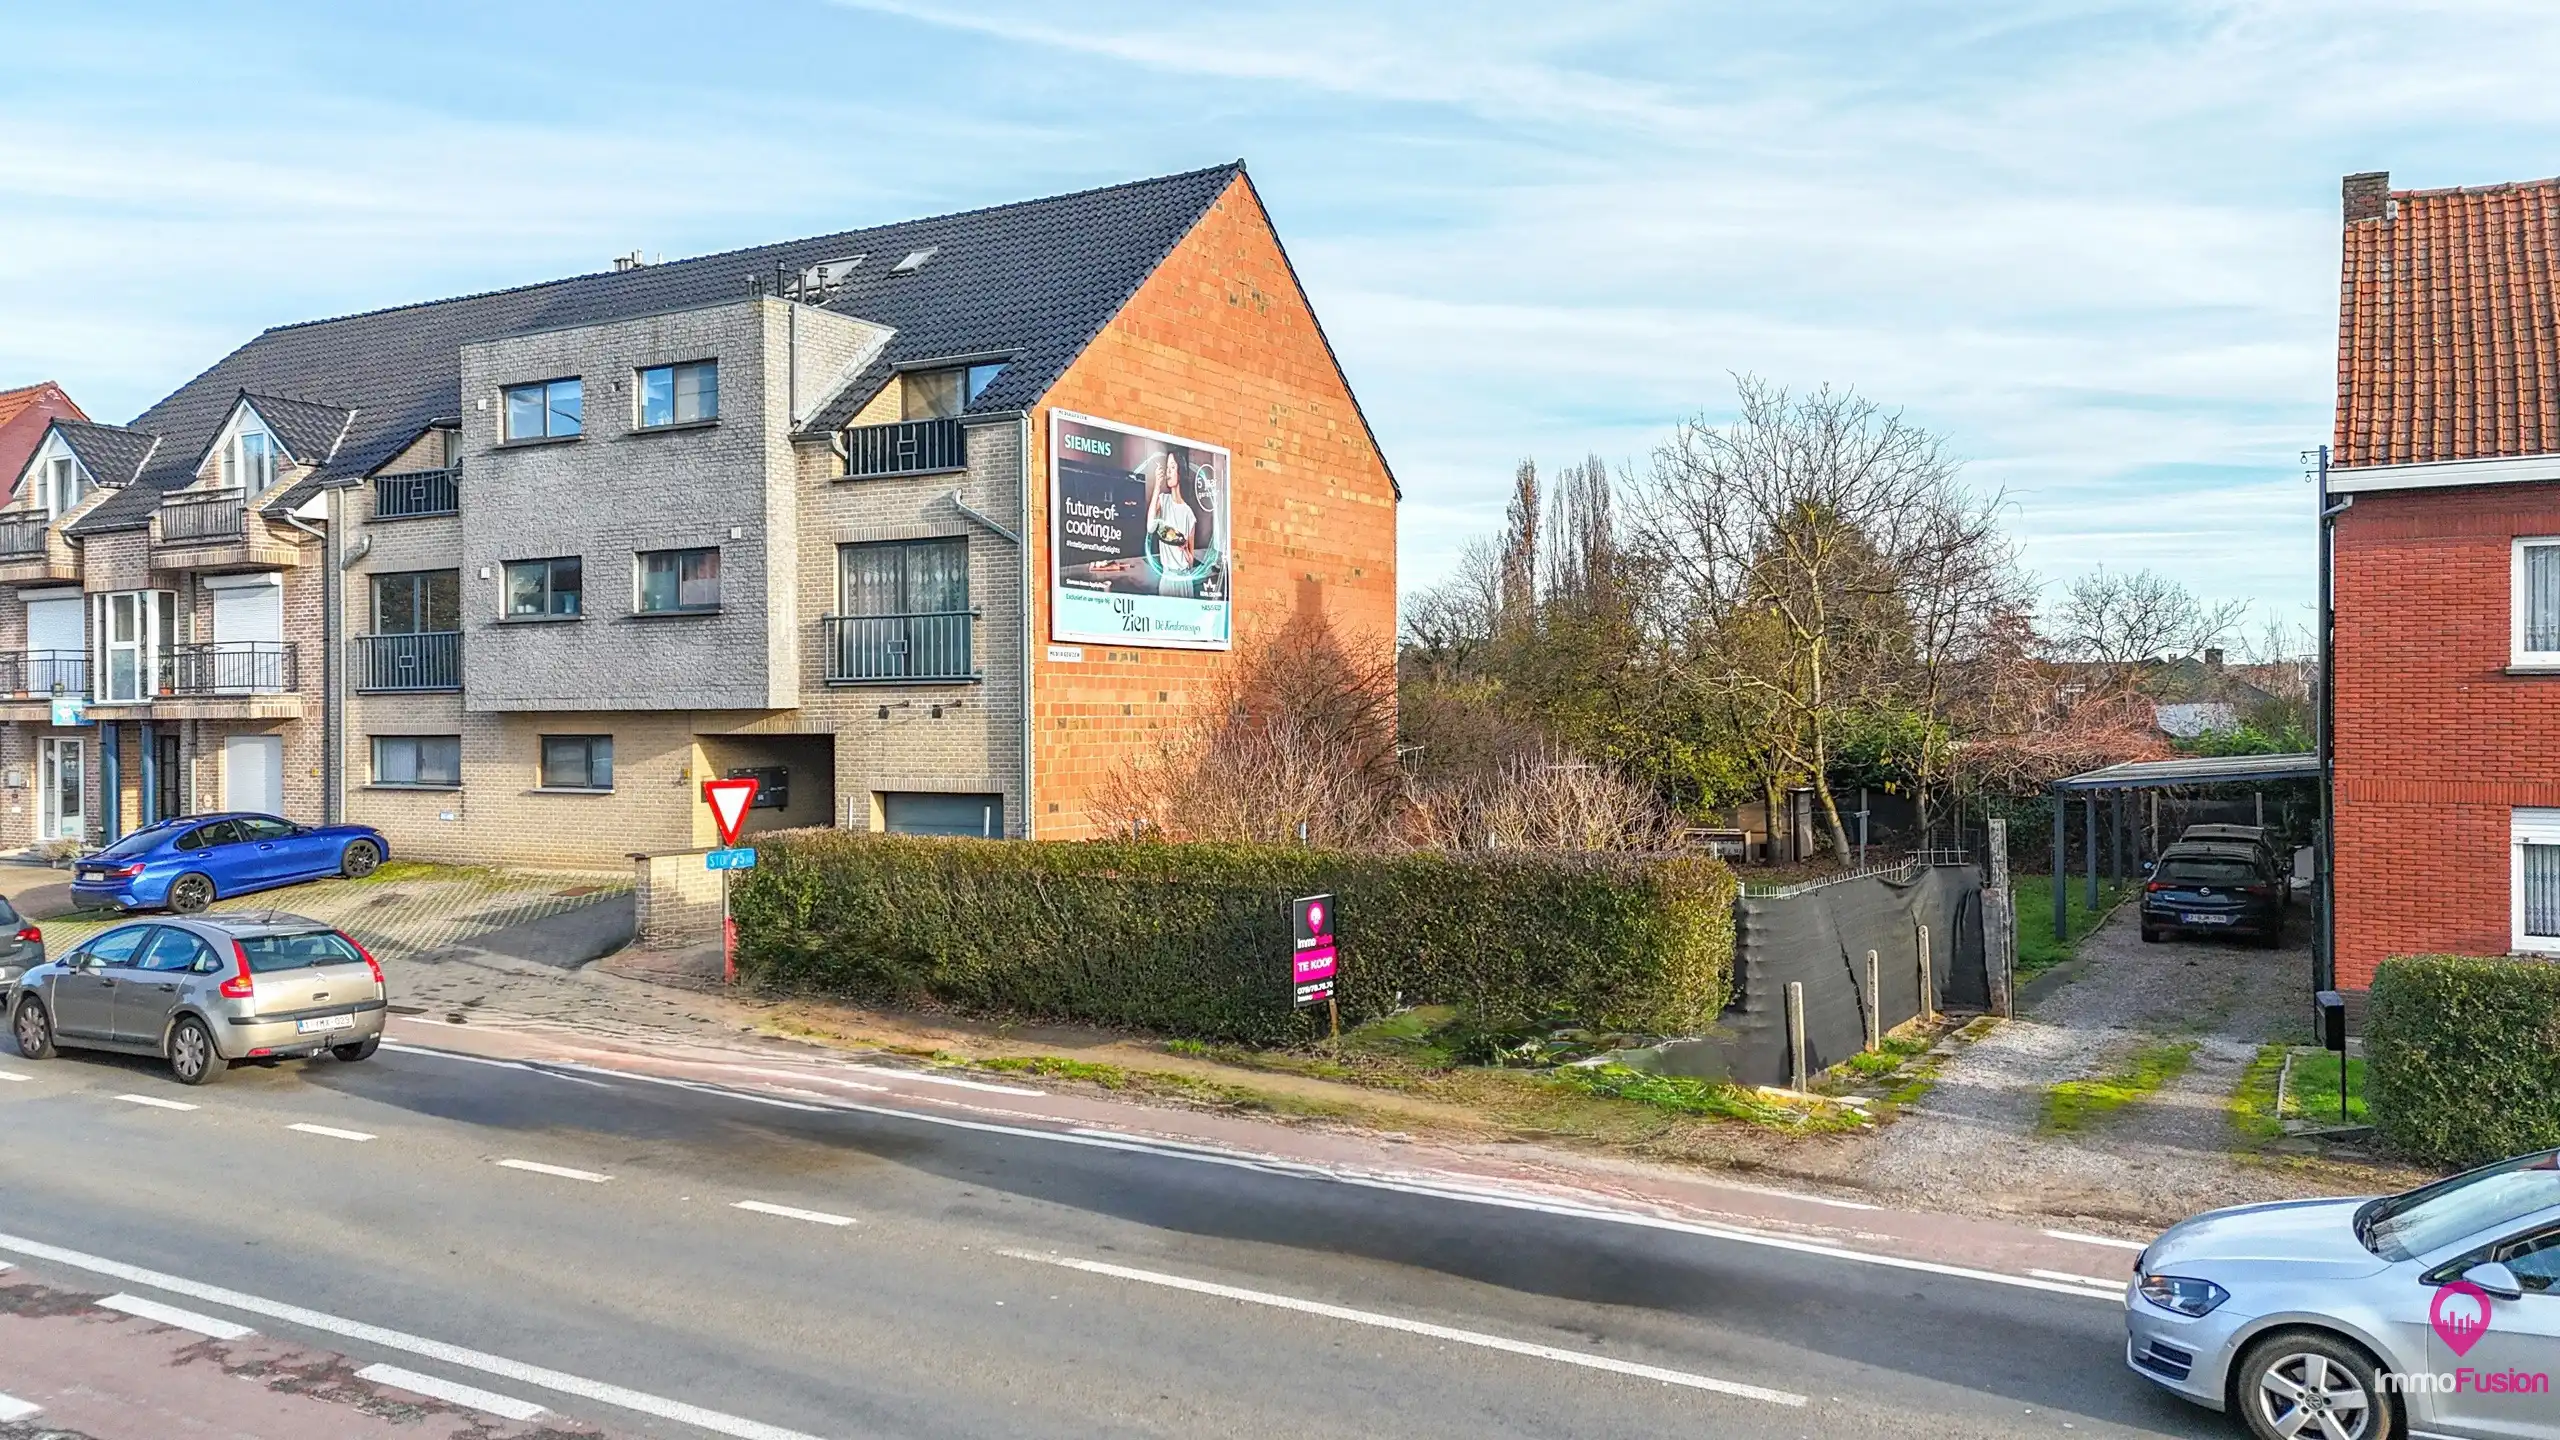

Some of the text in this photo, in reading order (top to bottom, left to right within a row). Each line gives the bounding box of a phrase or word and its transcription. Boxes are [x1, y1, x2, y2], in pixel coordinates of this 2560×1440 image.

[1064, 434, 1112, 457] SIEMENS
[1065, 496, 1119, 520] future-of-
[1065, 518, 1122, 543] cooking.be
[1122, 614, 1150, 633] zien
[1297, 957, 1333, 972] TE KOOP
